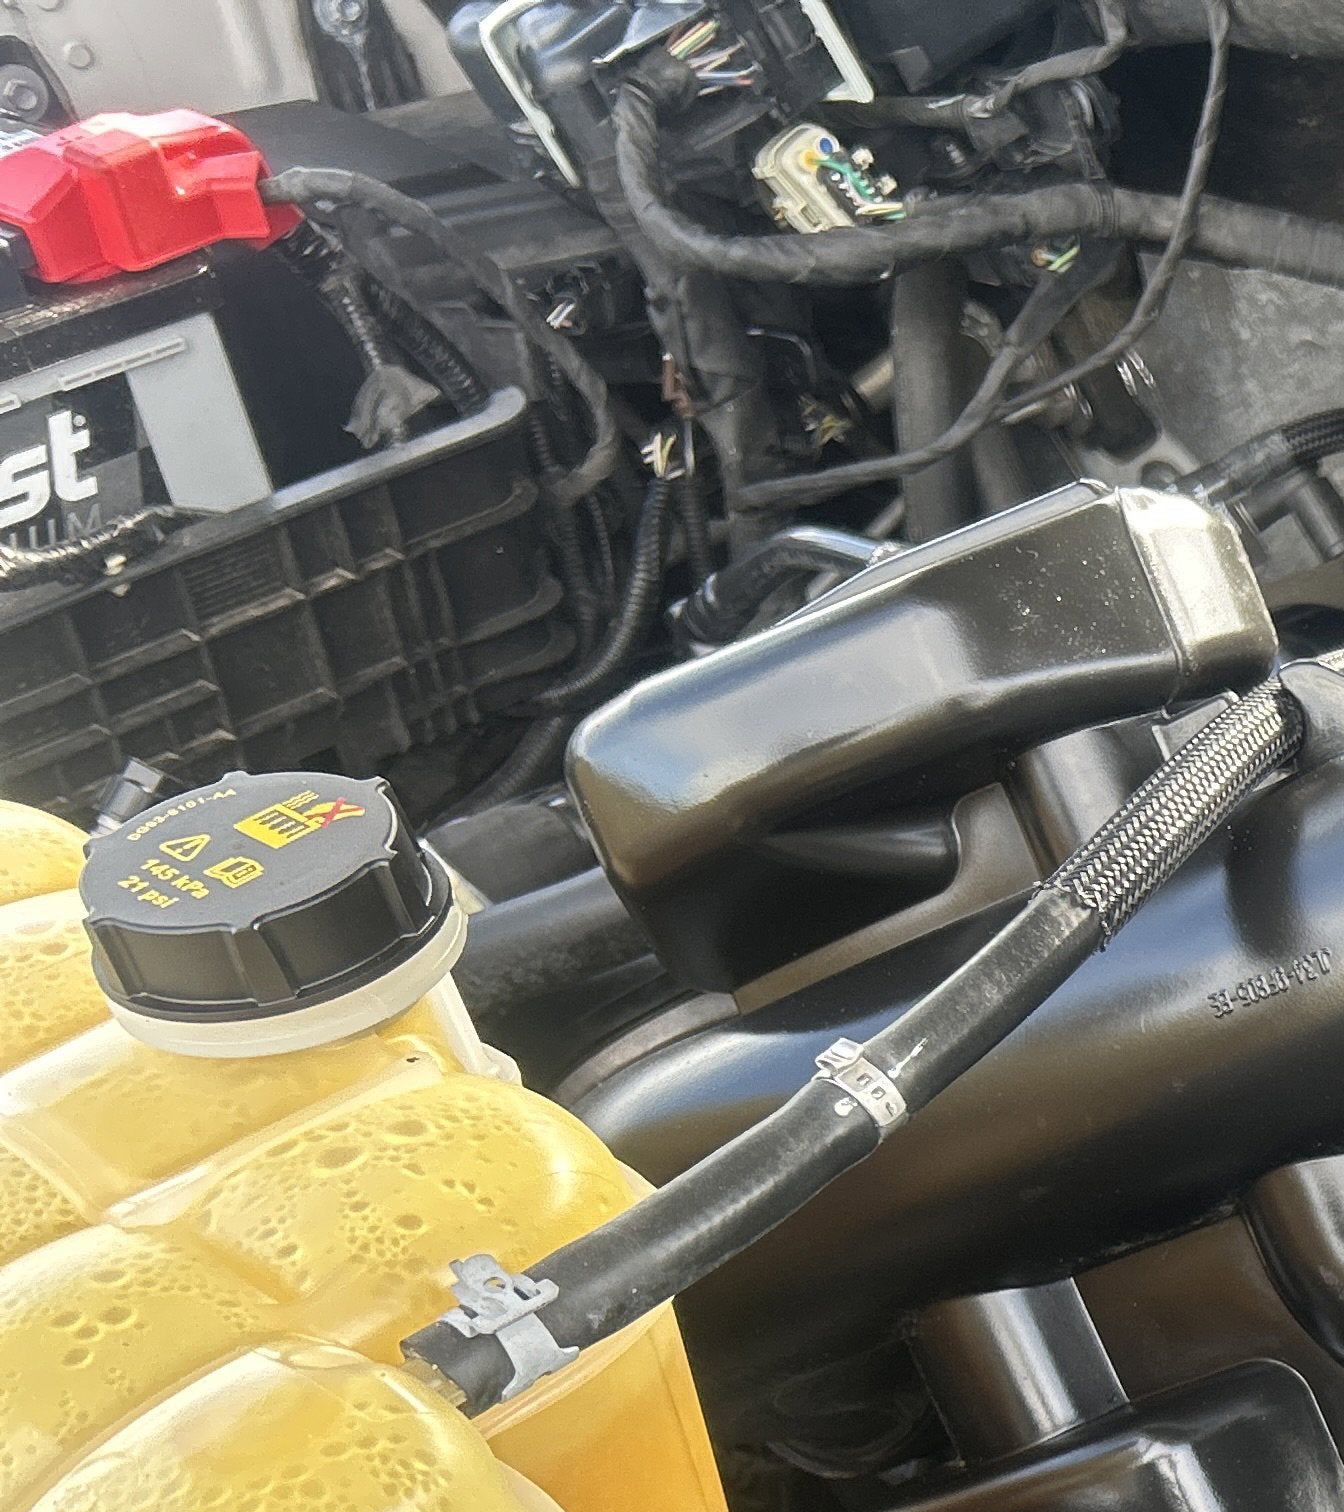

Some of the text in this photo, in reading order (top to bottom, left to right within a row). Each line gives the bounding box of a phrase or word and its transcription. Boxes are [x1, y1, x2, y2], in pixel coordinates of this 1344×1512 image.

[117, 875, 180, 909] 21 psi
[140, 859, 210, 899] 145 kPa
